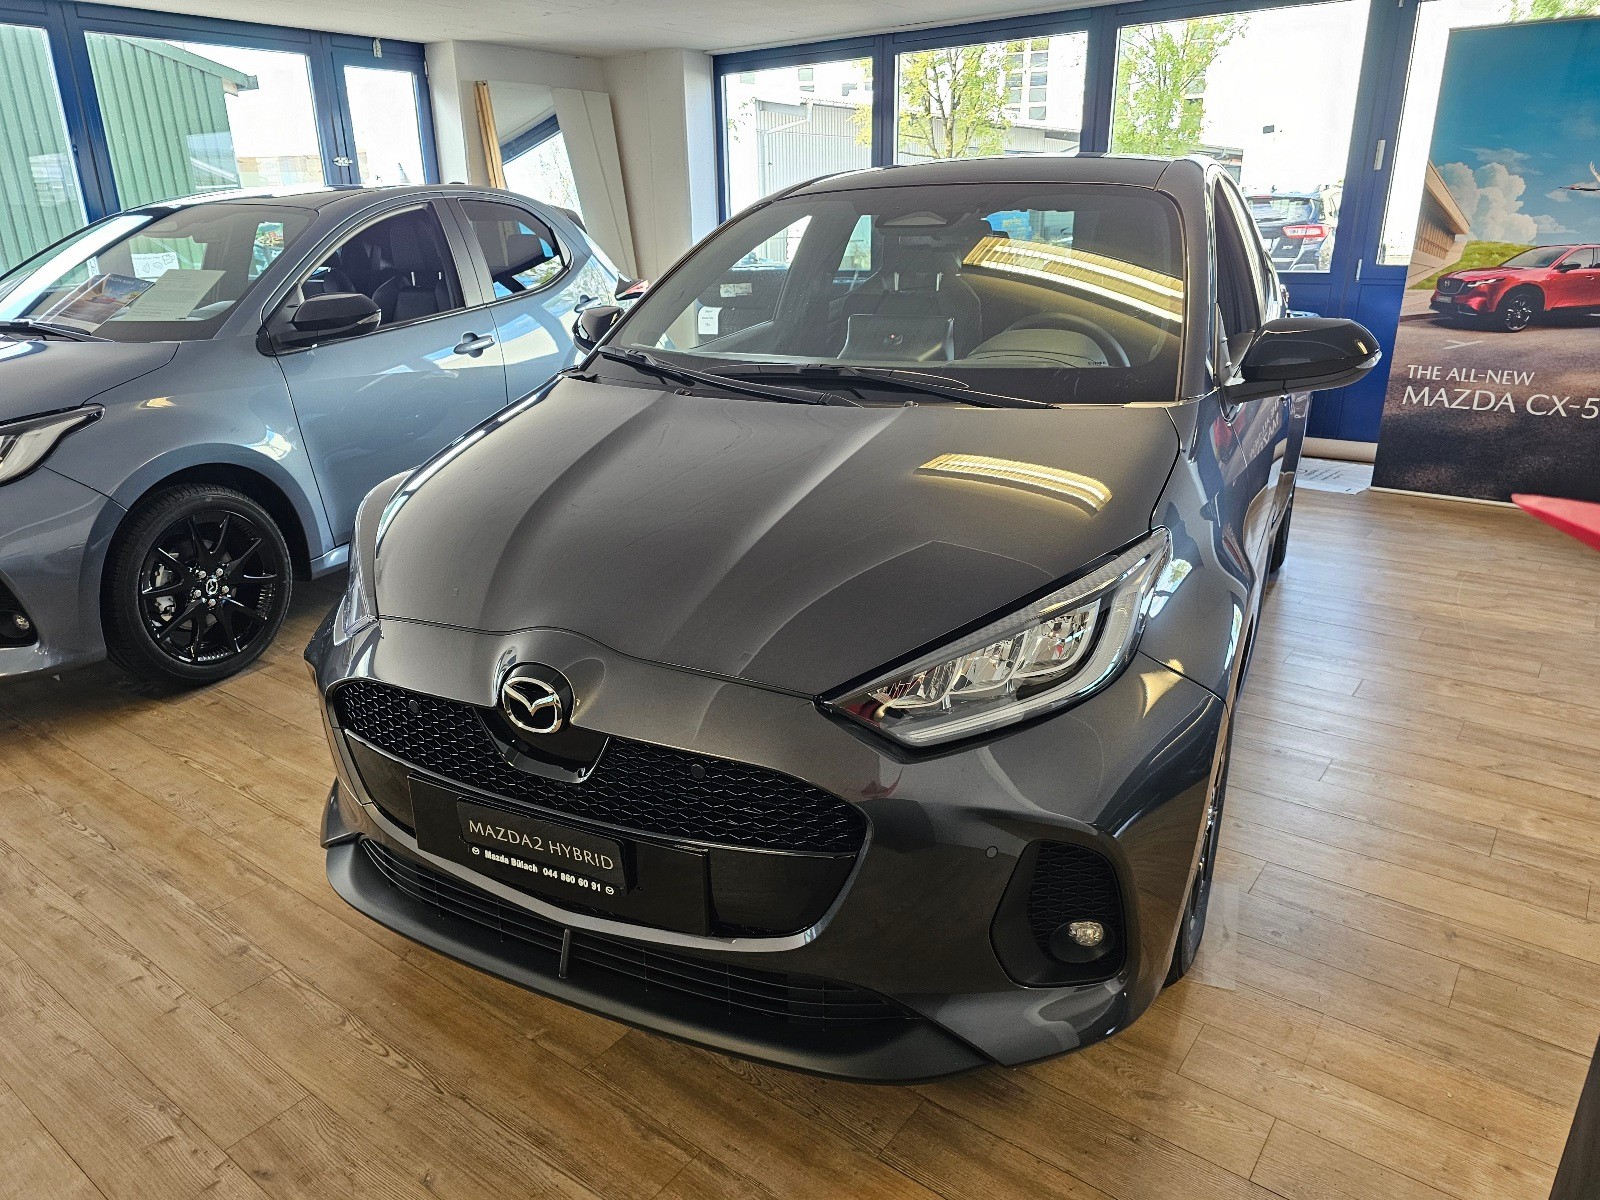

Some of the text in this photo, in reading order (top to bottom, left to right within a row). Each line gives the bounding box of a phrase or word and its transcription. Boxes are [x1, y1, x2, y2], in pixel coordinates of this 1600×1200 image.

[1407, 364, 1535, 386] THE ALL-NEW
[1402, 385, 1600, 419] MAZDA CX-5
[469, 819, 614, 870] MAZDA2 HYBRID
[484, 849, 509, 865] Mazda
[510, 857, 538, 873] Bülach
[542, 867, 558, 879] 044
[577, 877, 589, 888] 60
[590, 881, 601, 892] 91
